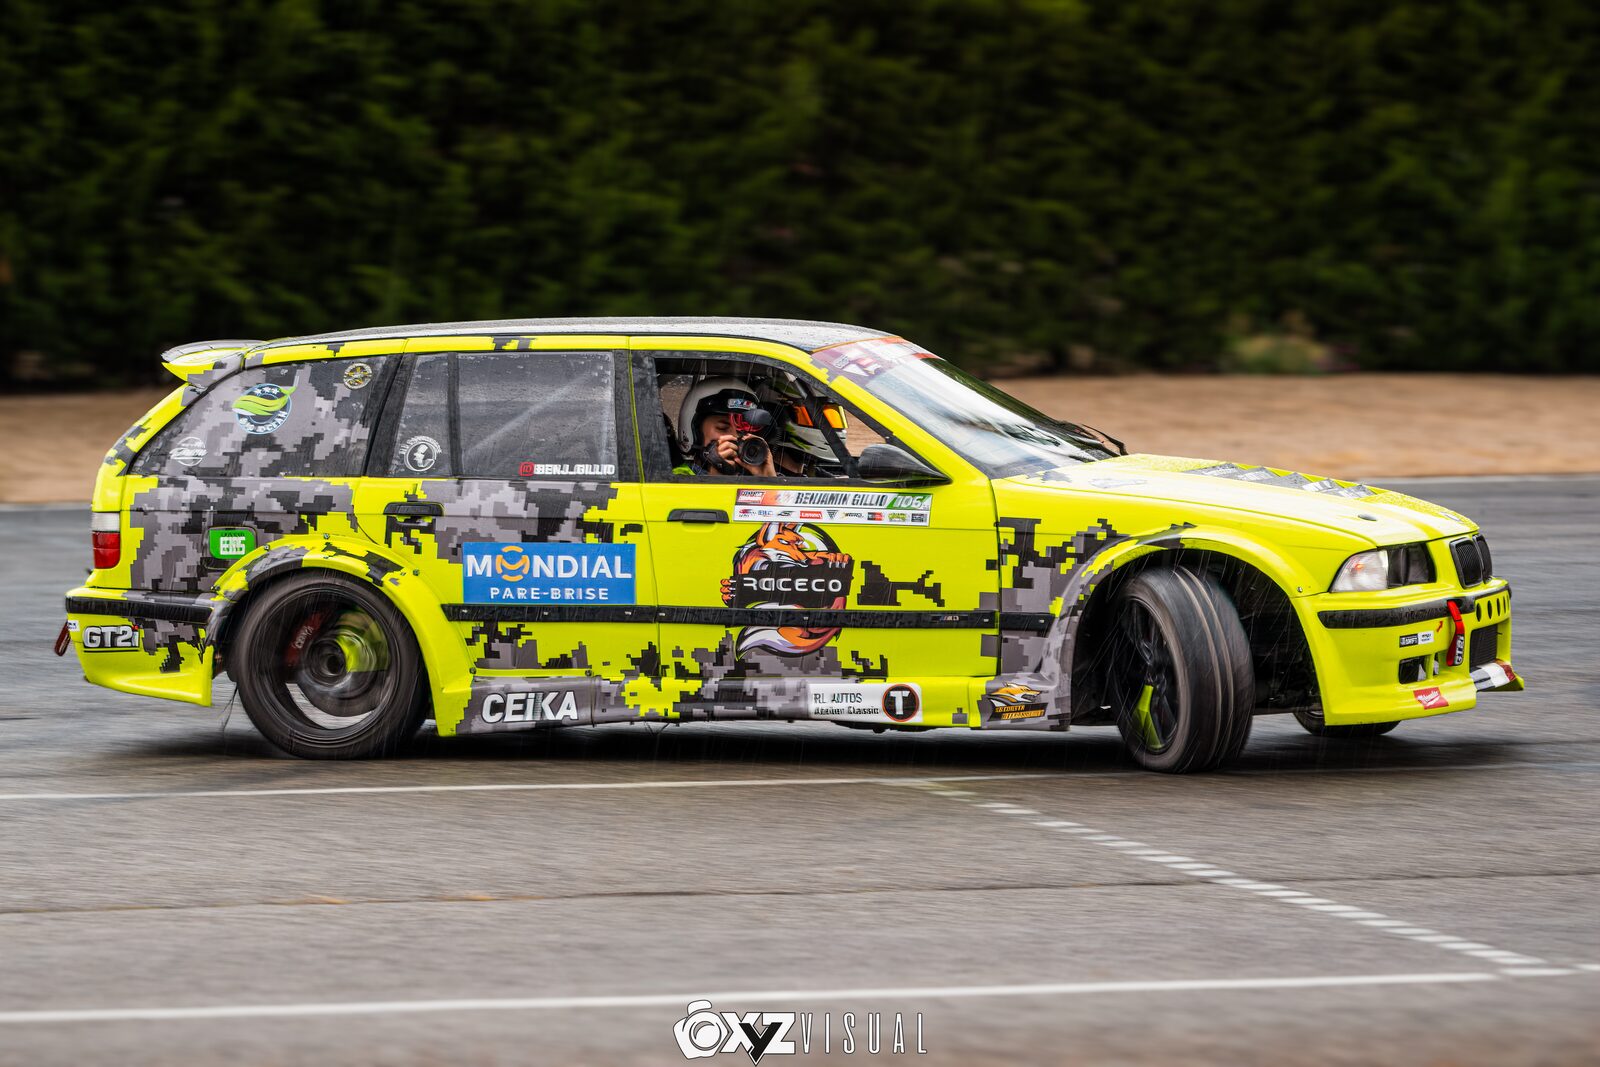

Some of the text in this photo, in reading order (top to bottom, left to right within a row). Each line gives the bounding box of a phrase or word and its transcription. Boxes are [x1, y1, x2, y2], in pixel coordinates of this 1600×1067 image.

[794, 491, 849, 506] BENJAMIN
[851, 493, 888, 507] GILLIO
[466, 546, 633, 582] MONDIAL
[743, 577, 843, 592] RACECO
[490, 587, 609, 600] PARE-BRISE
[831, 692, 863, 704] AUTOS
[847, 705, 880, 716] Classic
